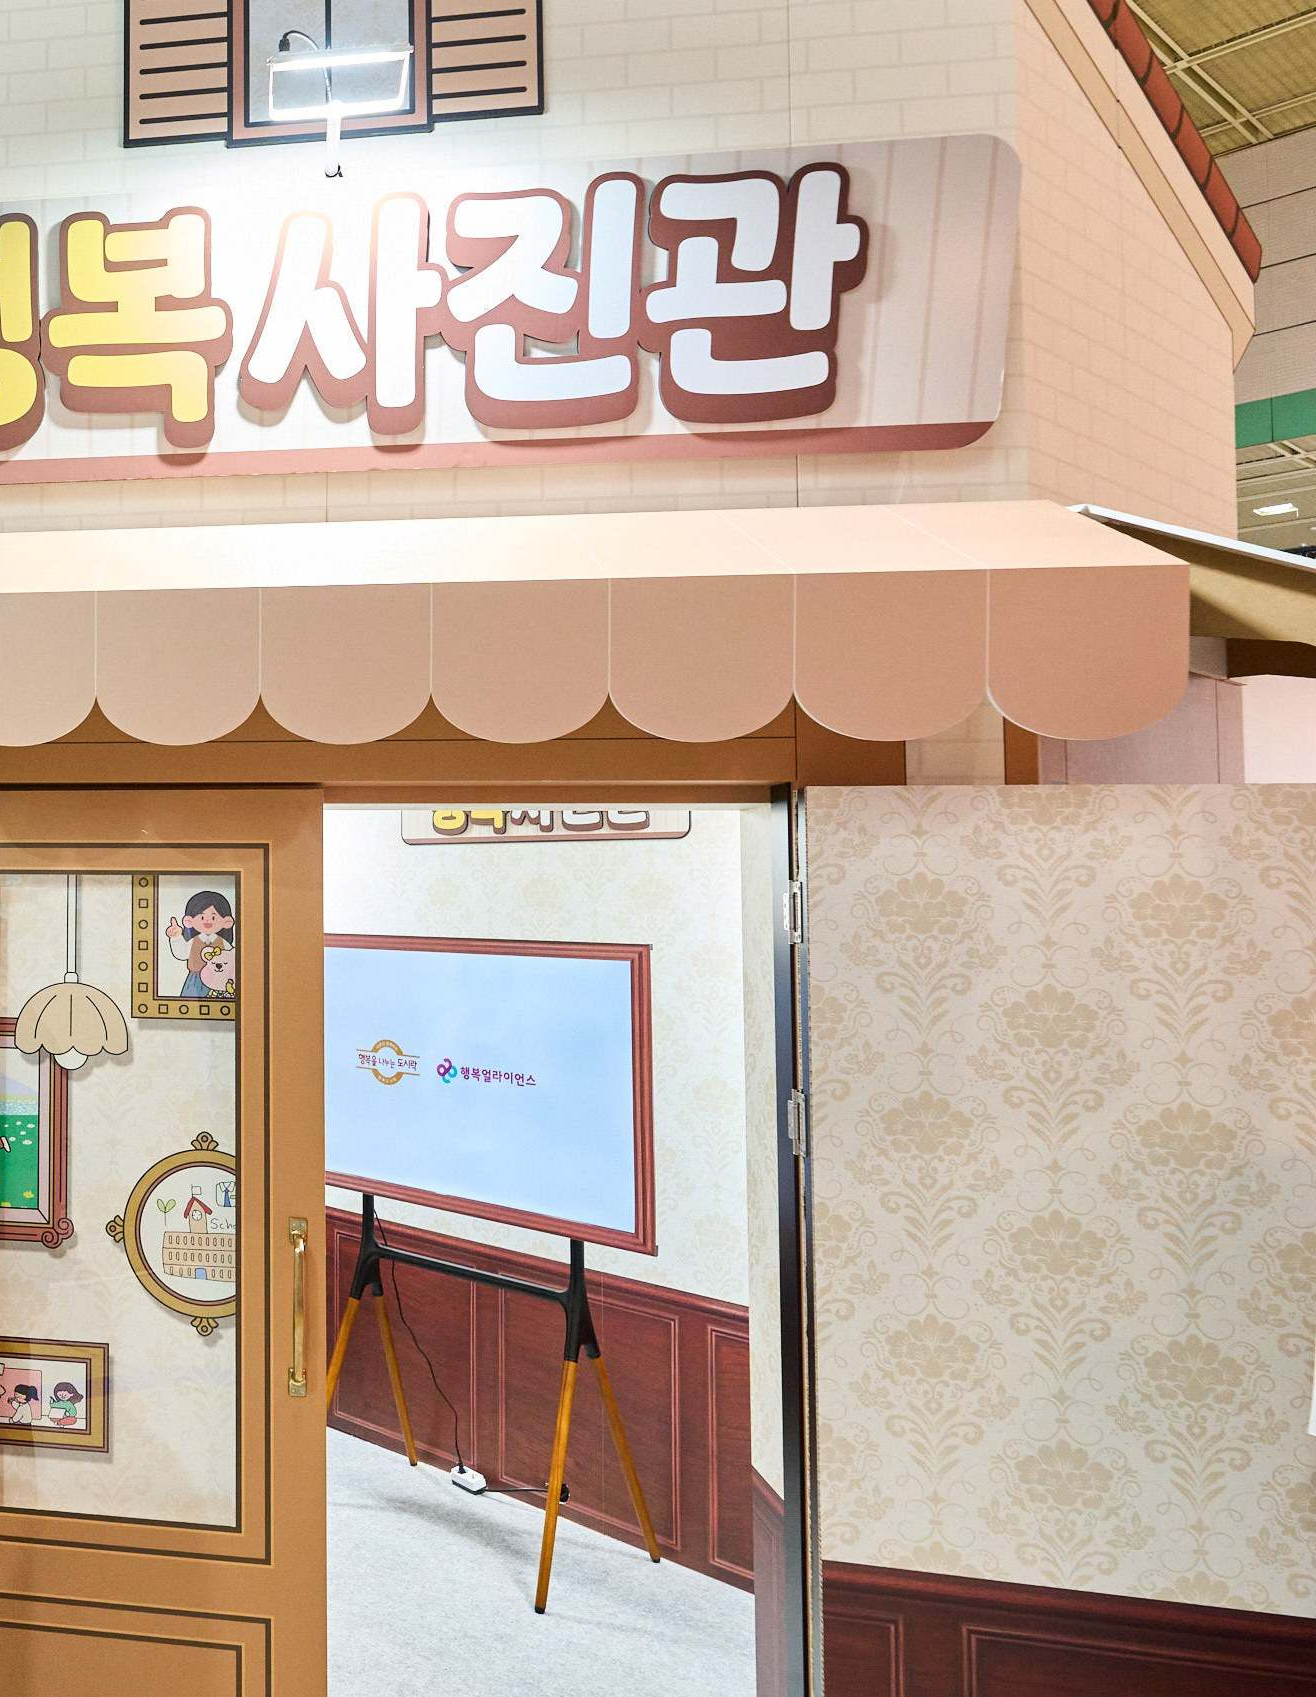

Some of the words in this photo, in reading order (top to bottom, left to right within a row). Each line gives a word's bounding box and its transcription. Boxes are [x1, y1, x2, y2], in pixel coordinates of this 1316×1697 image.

[397, 1058, 418, 1071] 도시락
[459, 1066, 537, 1087] 행복얼라이언스
[210, 1217, 236, 1230] Sch
